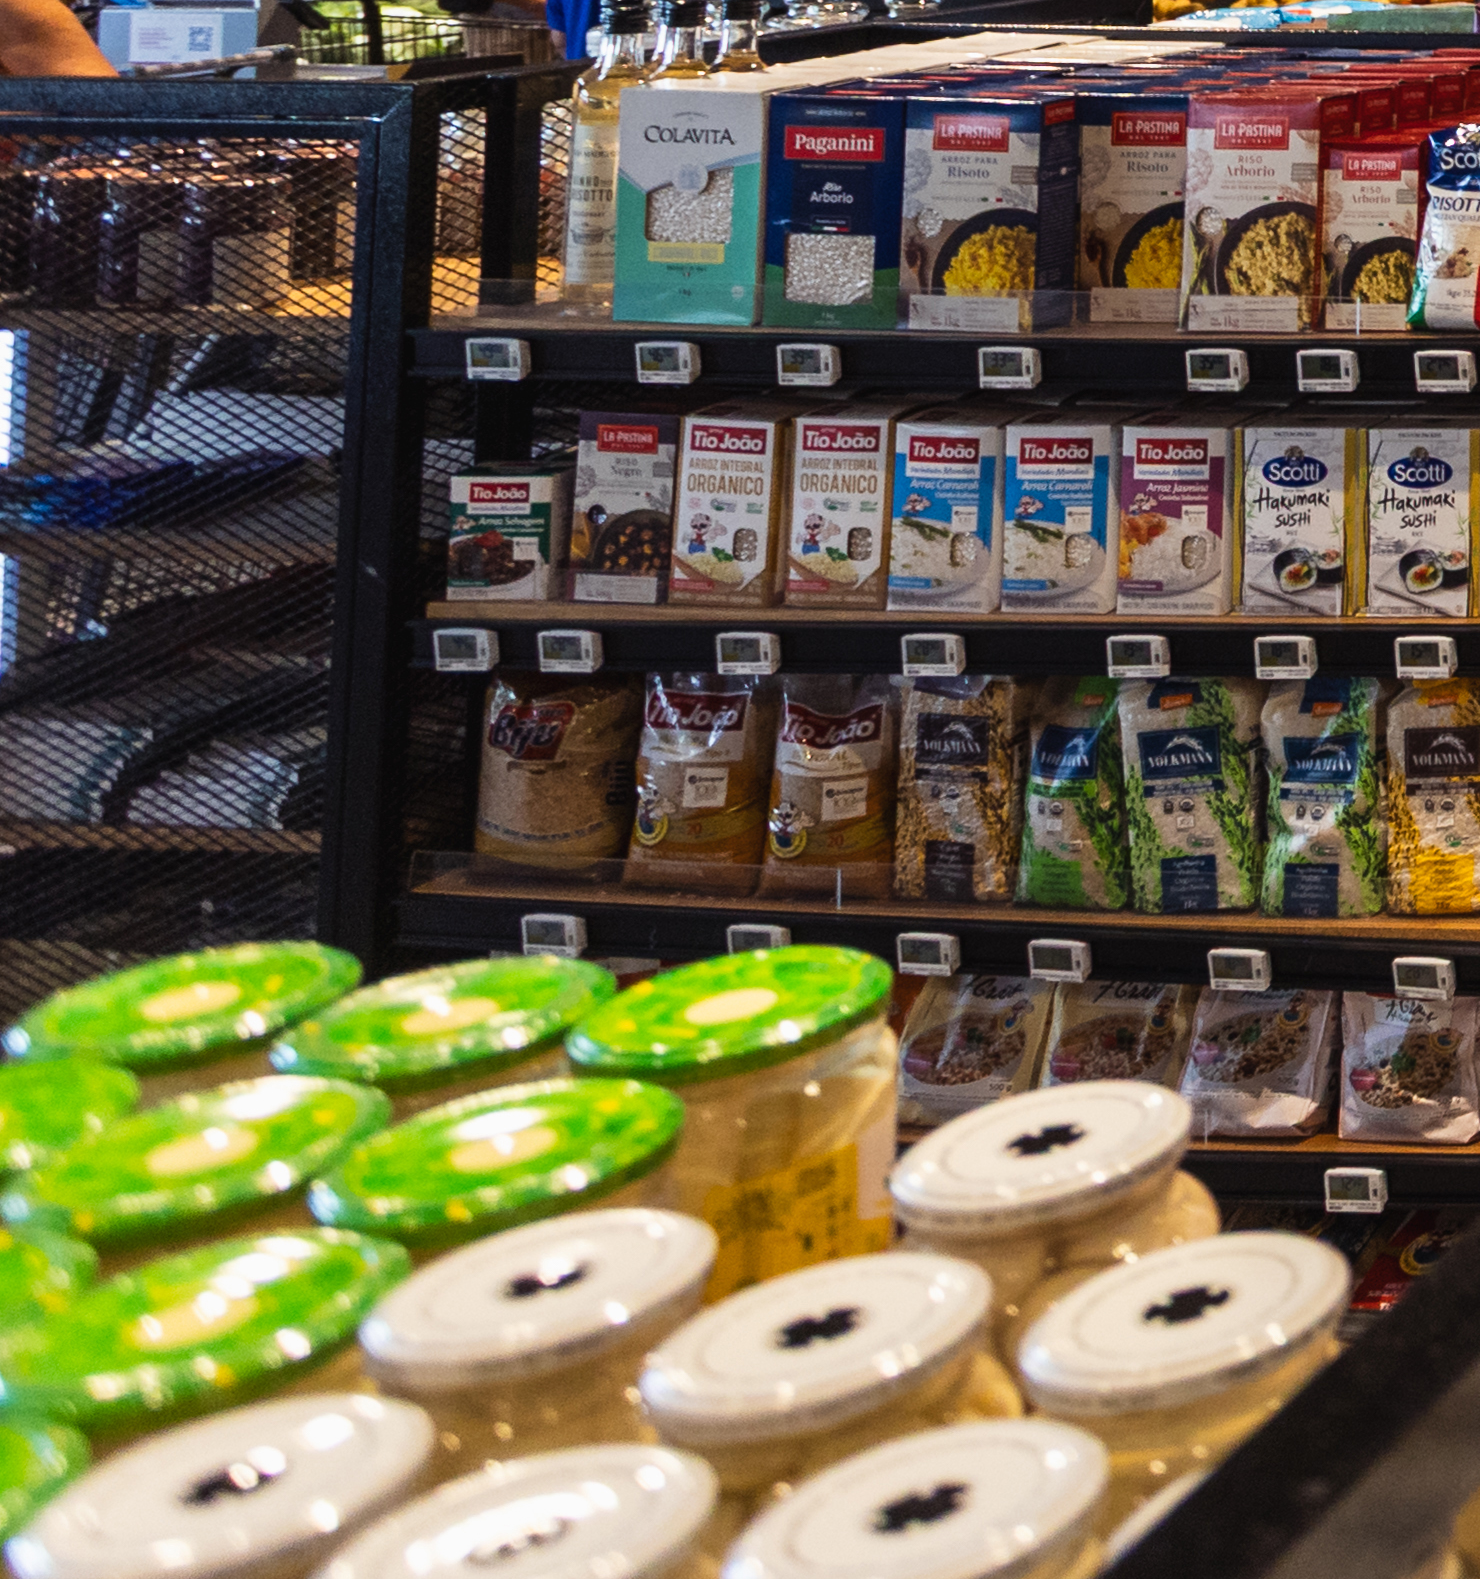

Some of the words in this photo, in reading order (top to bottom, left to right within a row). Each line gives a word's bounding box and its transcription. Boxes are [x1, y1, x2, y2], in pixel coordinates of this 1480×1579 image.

[1119, 120, 1132, 133] LA
[1134, 120, 1179, 134] PASTINA
[1222, 123, 1236, 137] LA
[1238, 123, 1282, 137] PASTINA
[644, 125, 735, 145] COLAVITA
[794, 133, 875, 153] Paganini
[1238, 155, 1263, 164] RISO
[1349, 159, 1359, 171] LA
[1362, 159, 1396, 171] PASTINA
[947, 166, 990, 179] Risoto
[1127, 161, 1169, 174] Risoto
[1226, 165, 1275, 178] Arborio
[810, 190, 853, 204] Arborio
[1360, 186, 1381, 194] RISO
[1024, 443, 1048, 459] Tio
[1048, 443, 1090, 459] João
[1140, 443, 1163, 459] Tio
[1164, 444, 1205, 460] João
[829, 457, 878, 472] INTEGRAL
[1268, 462, 1321, 484] Scotti
[1393, 462, 1446, 484] Scotti
[687, 470, 764, 495] ORGÂNICO
[1253, 487, 1330, 515] Hakumaki
